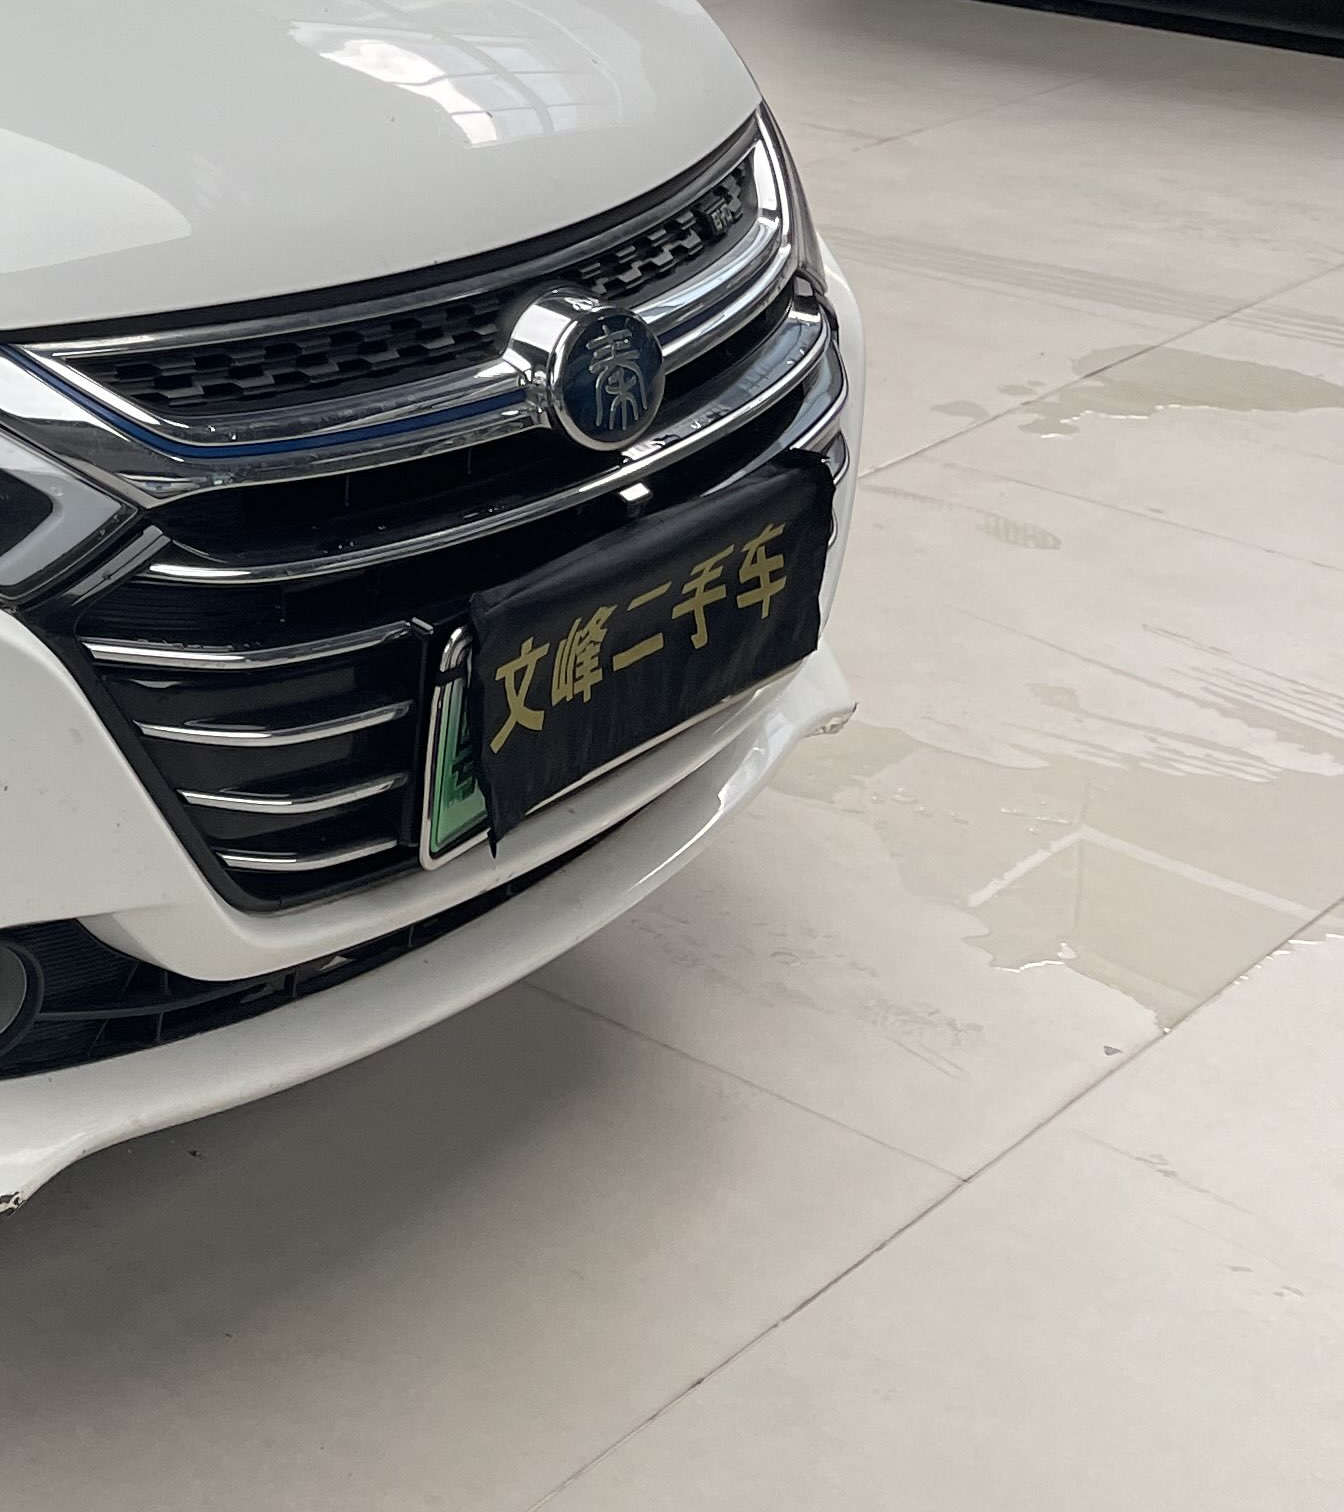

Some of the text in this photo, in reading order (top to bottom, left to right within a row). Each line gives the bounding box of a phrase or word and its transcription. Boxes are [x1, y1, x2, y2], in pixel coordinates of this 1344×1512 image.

[489, 522, 788, 755] 文峰二手车
